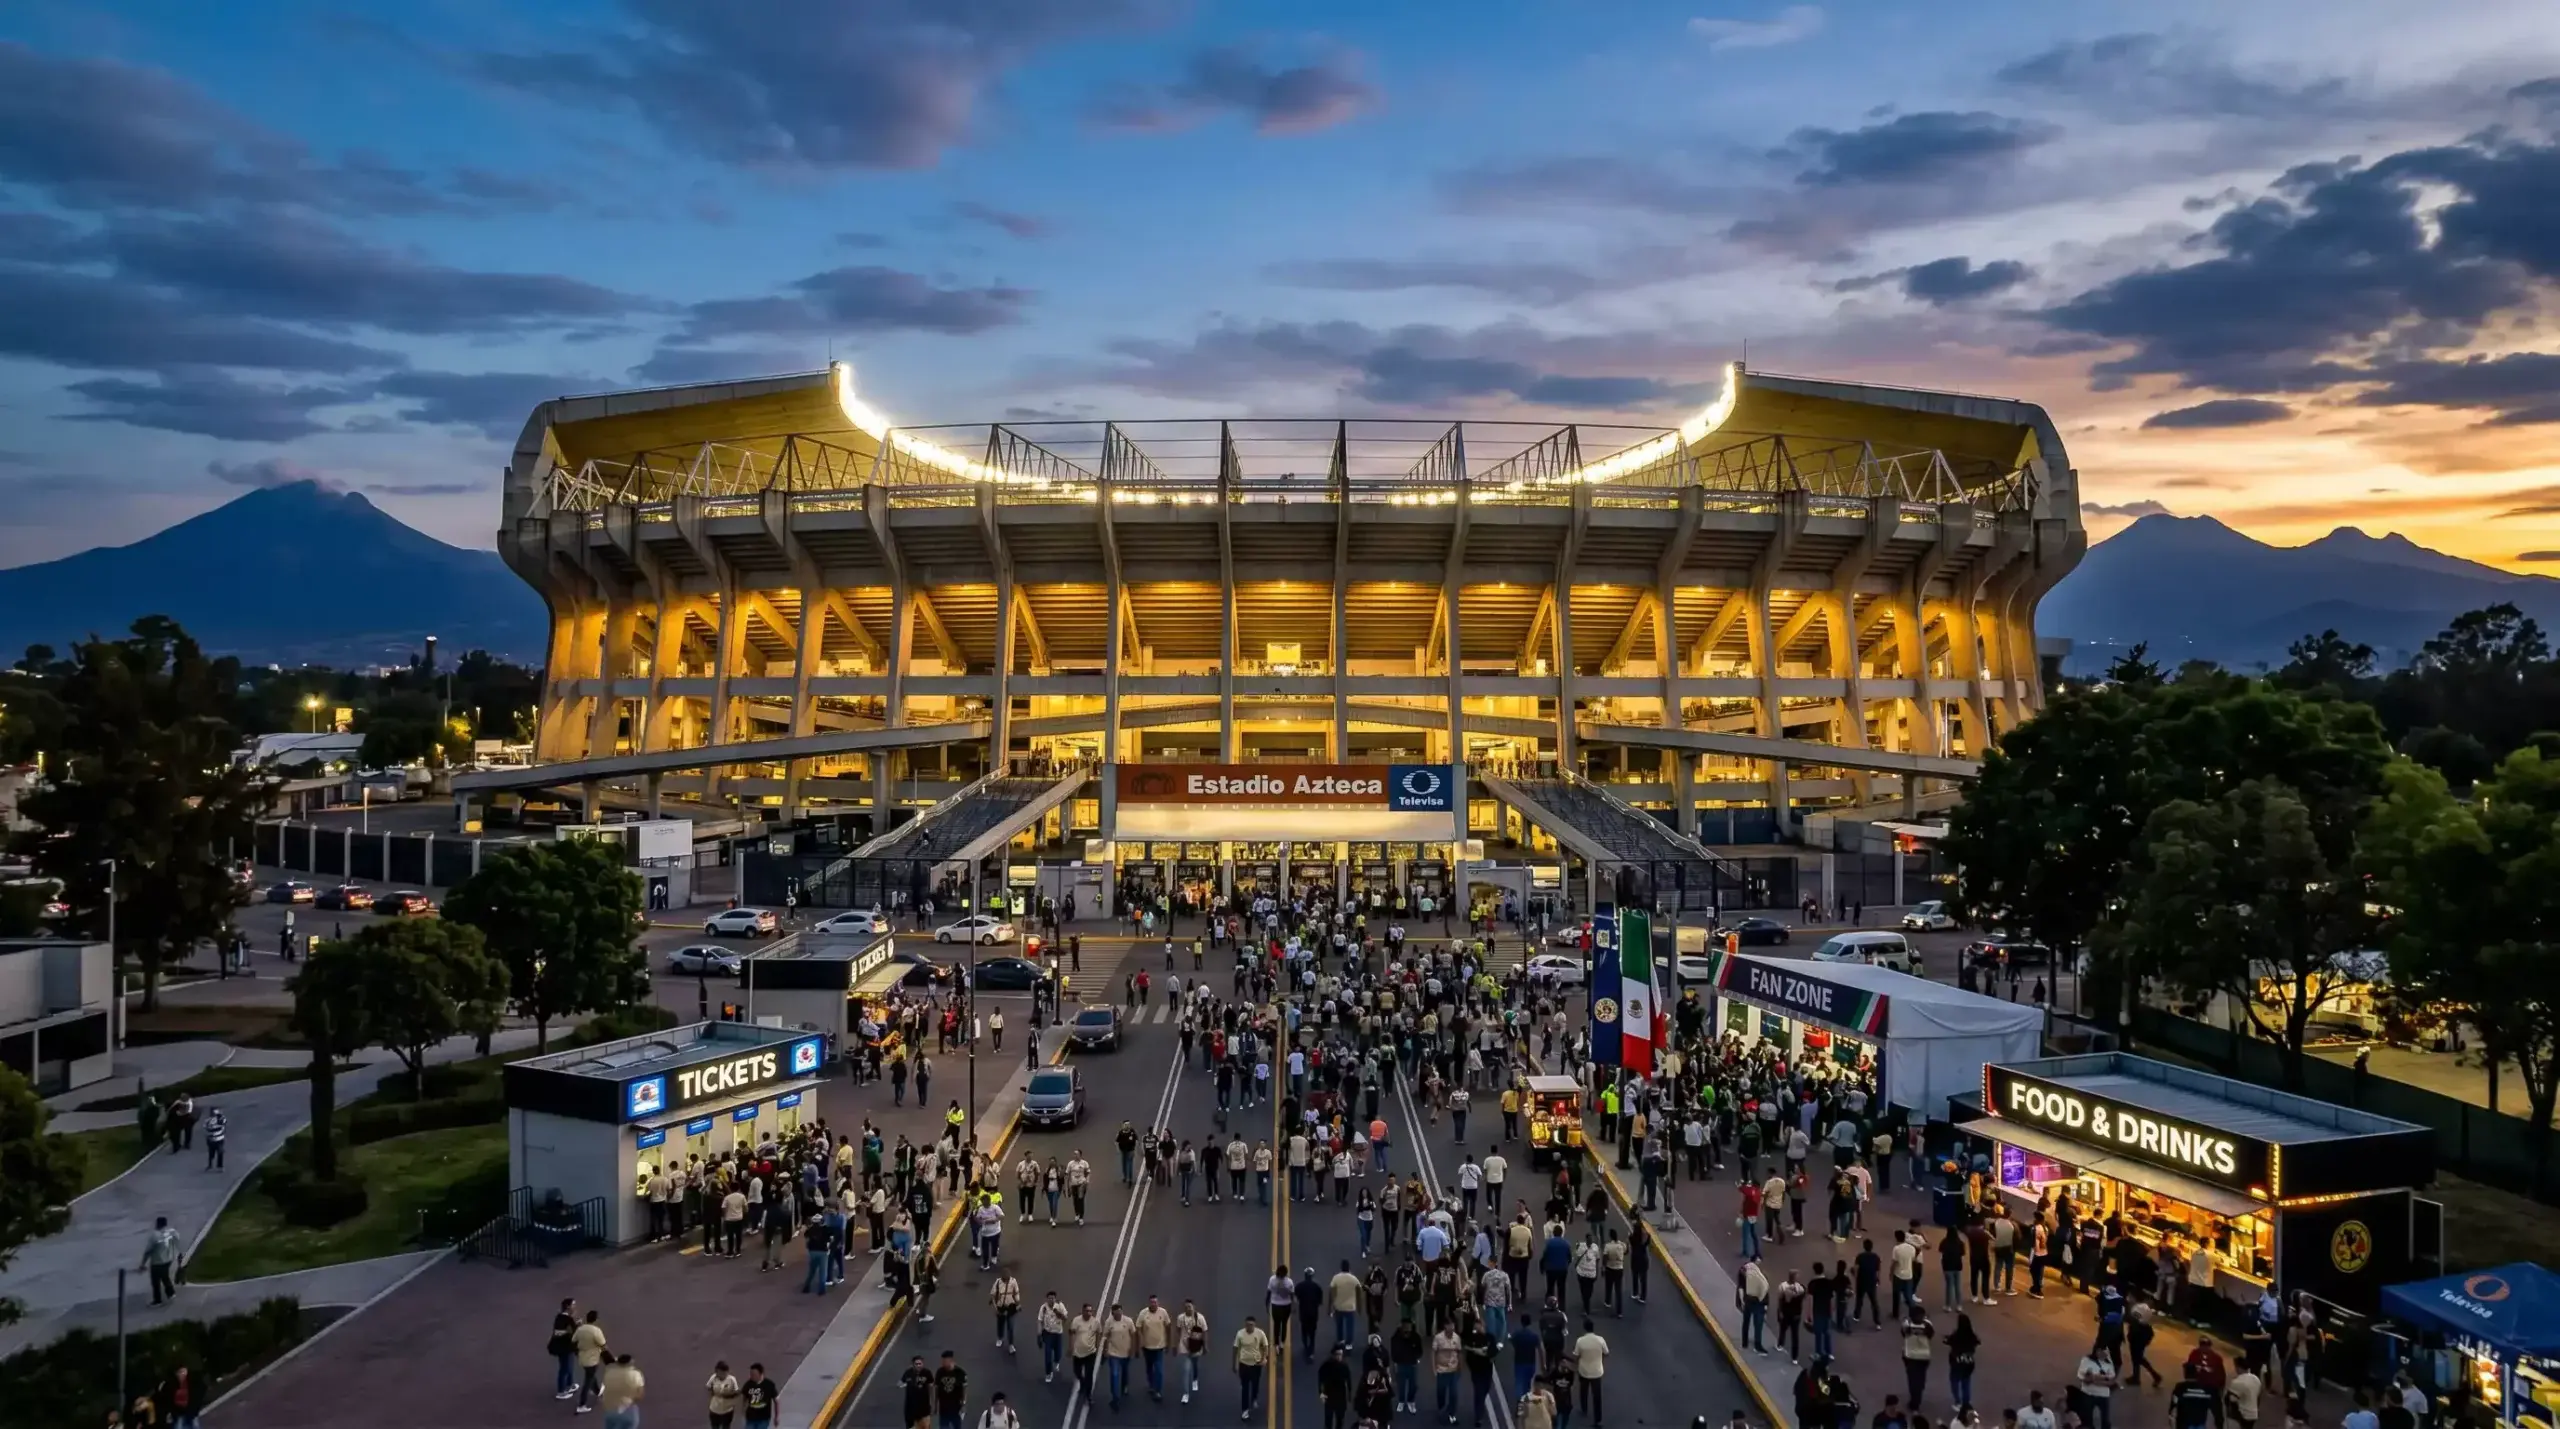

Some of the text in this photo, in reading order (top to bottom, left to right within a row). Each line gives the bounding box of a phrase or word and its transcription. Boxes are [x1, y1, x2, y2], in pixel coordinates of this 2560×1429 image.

[1188, 774, 1383, 794] Estadio Azteca
[1398, 796, 1444, 806] Televisa
[1751, 968, 1832, 1012] FAN ZONE
[678, 1052, 777, 1099] TICKETS
[2011, 1082, 2236, 1175] FOOD & DRINKS
